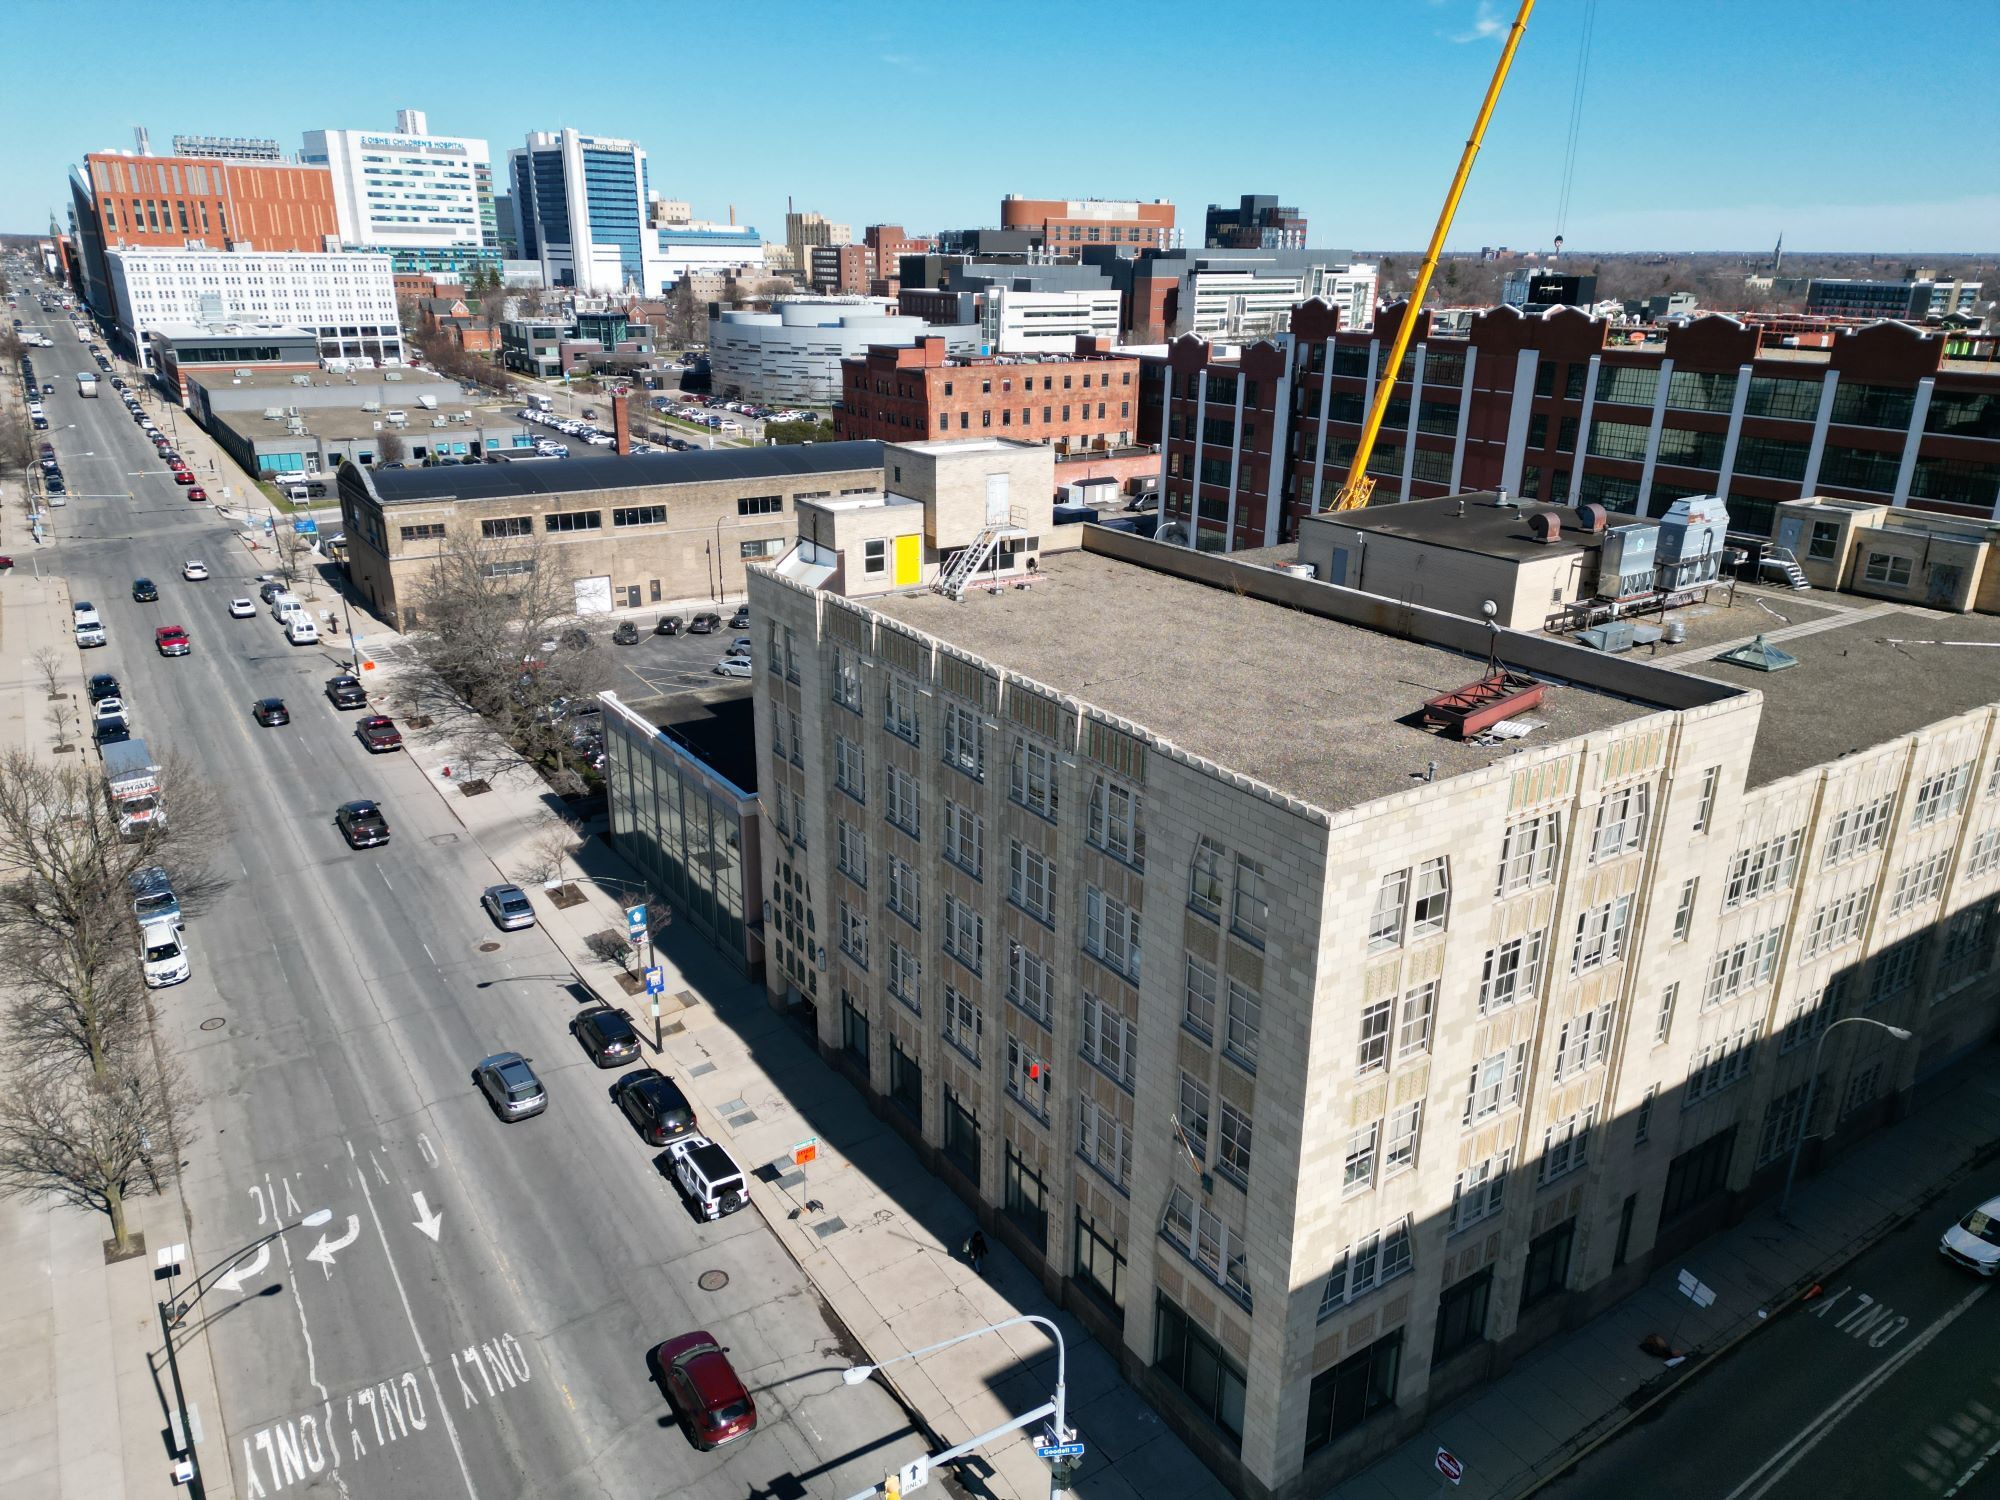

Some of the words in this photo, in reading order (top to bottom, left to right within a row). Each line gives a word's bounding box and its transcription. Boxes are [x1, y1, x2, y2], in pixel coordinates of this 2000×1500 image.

[367, 137, 390, 145] OISHEI
[392, 138, 433, 148] CHILDREN'S
[1808, 1286, 1910, 1348] ONLY
[450, 1332, 530, 1409] ONLY
[347, 1372, 427, 1461] ONLY
[243, 1414, 325, 1500] ONLY
[1043, 1447, 1070, 1455] Goodell
[905, 1479, 923, 1491] ONLY
